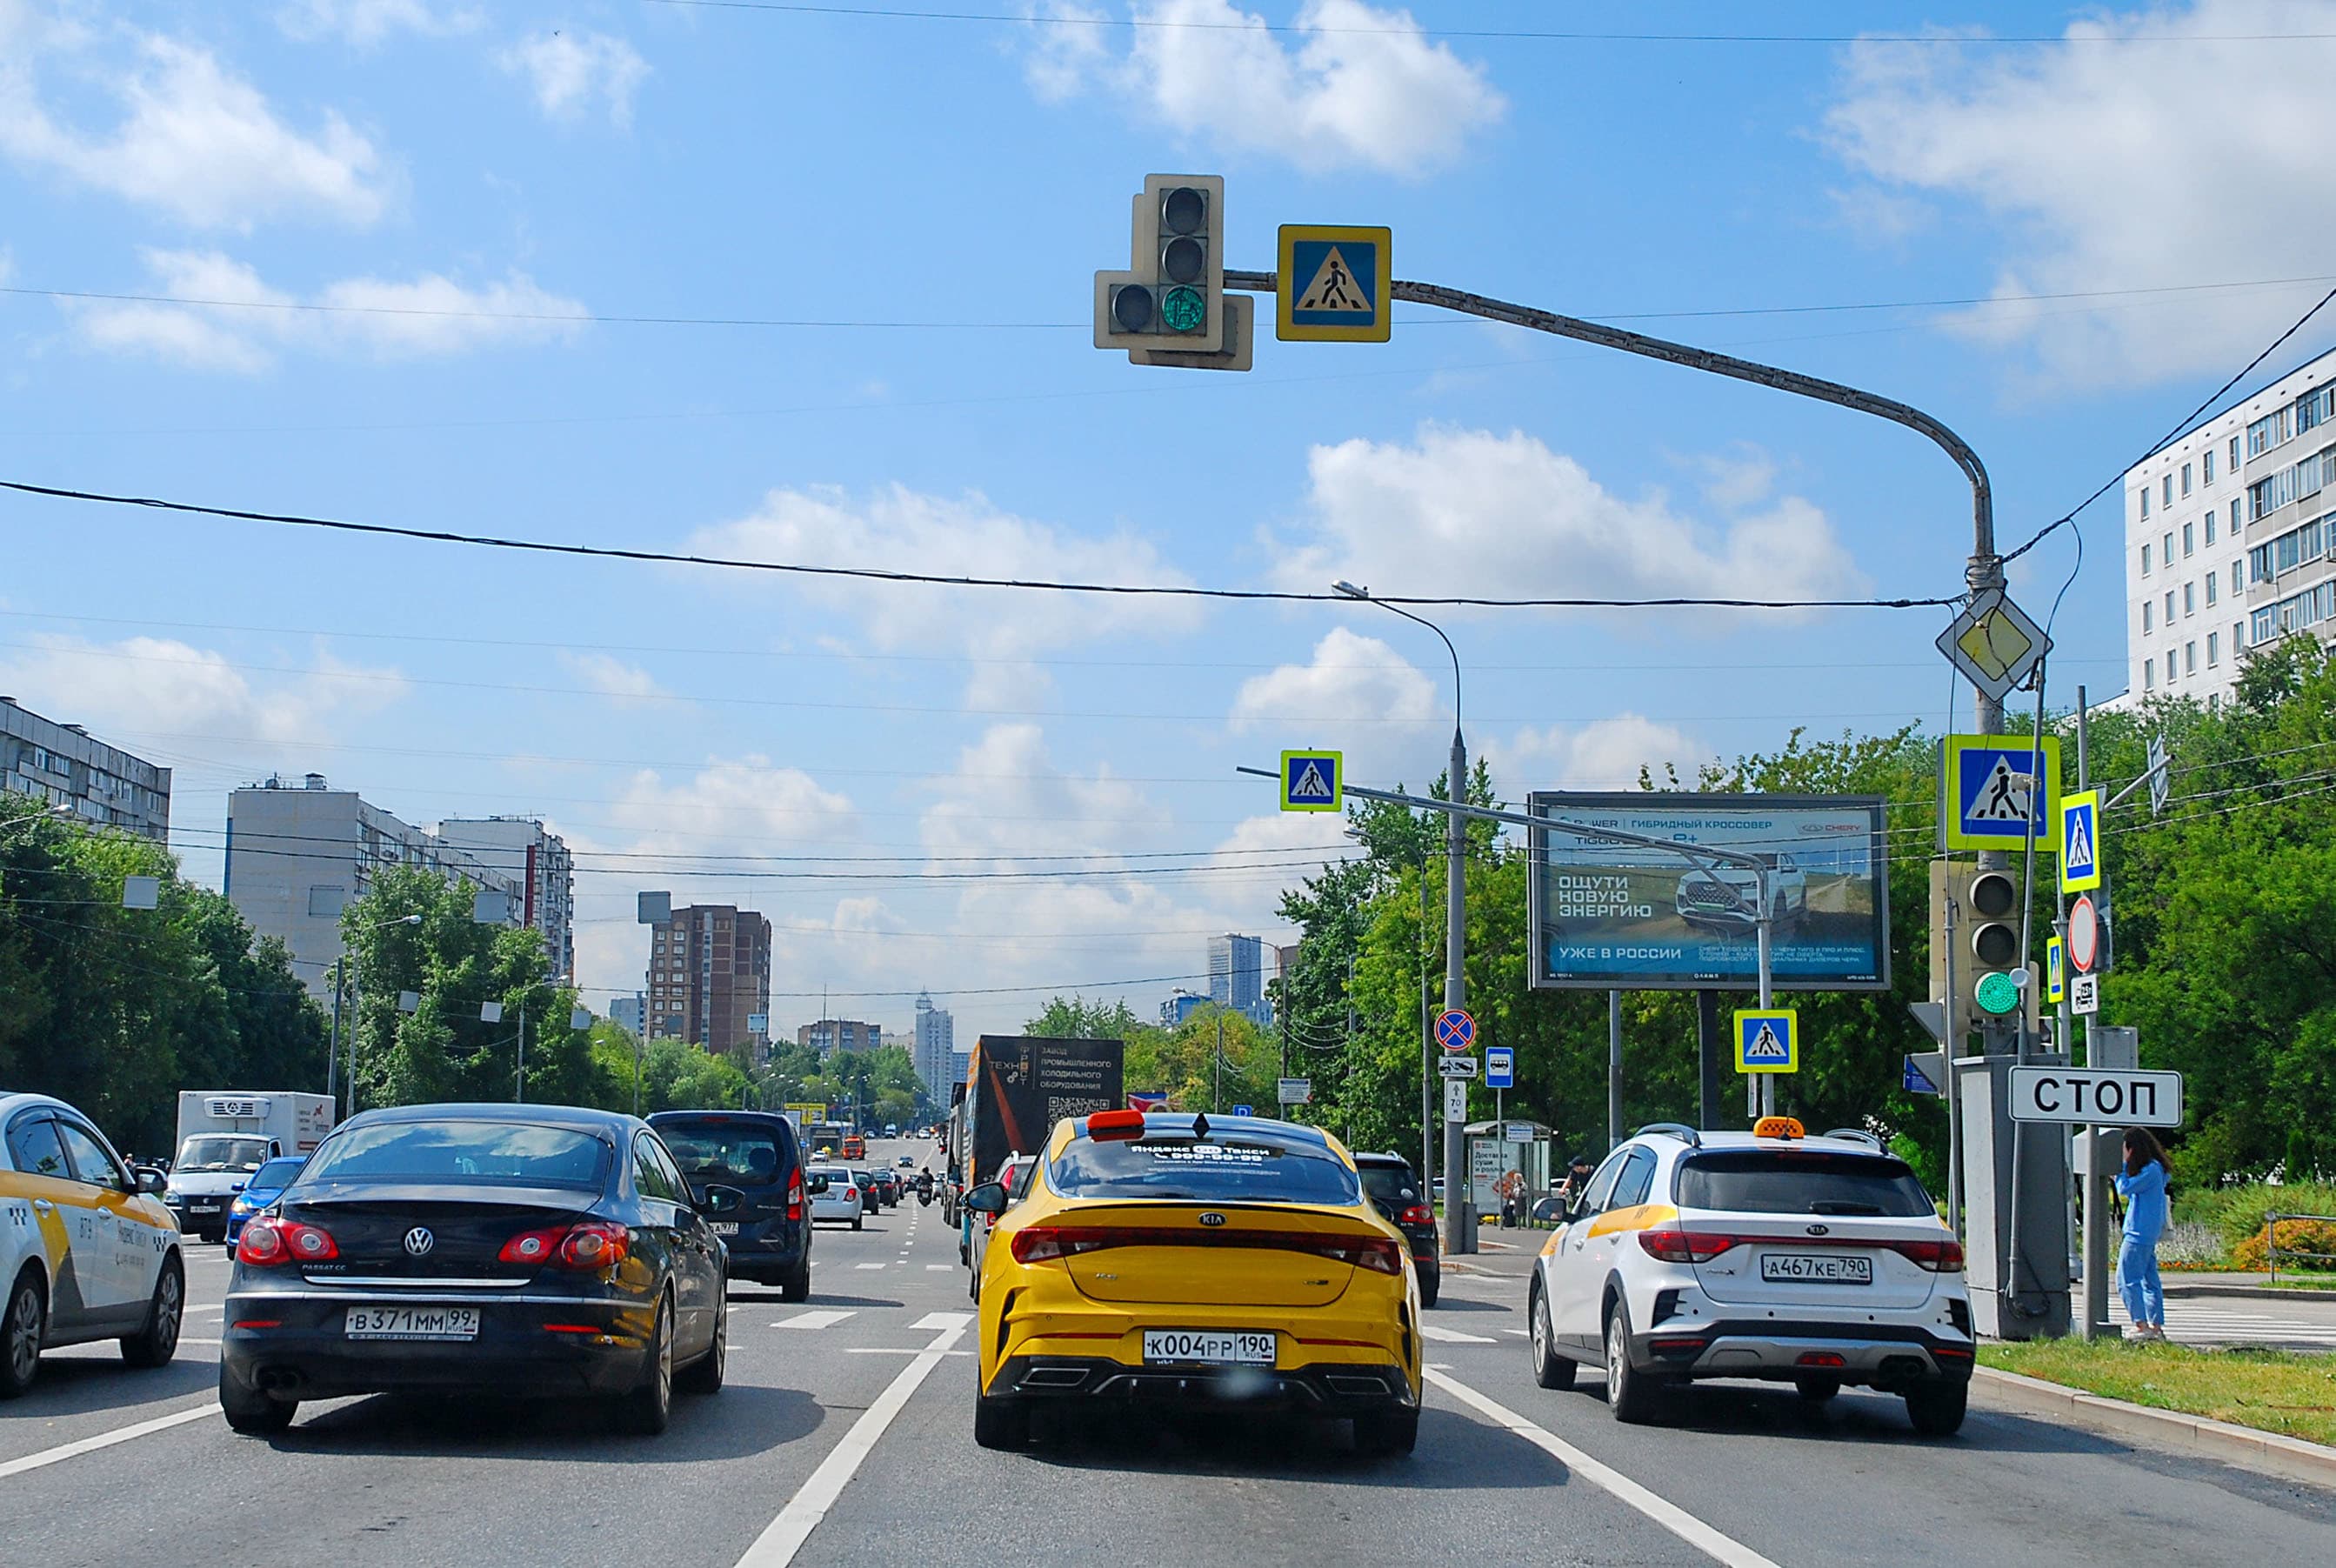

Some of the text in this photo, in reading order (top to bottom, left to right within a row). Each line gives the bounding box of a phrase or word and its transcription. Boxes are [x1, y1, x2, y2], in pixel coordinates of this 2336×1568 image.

[1632, 819, 1702, 829] ГИБРИДНЫЙ
[1559, 876, 1628, 890] ОЩУТИ
[1559, 891, 1629, 903] НОВУЮ
[1559, 905, 1652, 917] ЭНЕРГИЮ
[1559, 948, 1682, 958] УЖЕ В РОССИИ
[1042, 1047, 1067, 1056] ЗАВОД
[1041, 1058, 1112, 1069] ПРОМЫШЛЕННОГО
[1041, 1071, 1102, 1080] ХОЛОДИЛЬНОГО
[1040, 1081, 1101, 1091] ОБОРУДОВАНИЯ
[2034, 1077, 2156, 1116] СТОП
[1451, 1098, 1462, 1107] 70
[1131, 1145, 1190, 1154] Яндекс
[1223, 1147, 1271, 1156] Такси
[1203, 1215, 1222, 1224] KIA
[1809, 1224, 1826, 1235] KIA
[450, 1310, 471, 1325] 99
[1238, 1336, 1269, 1352] 190
